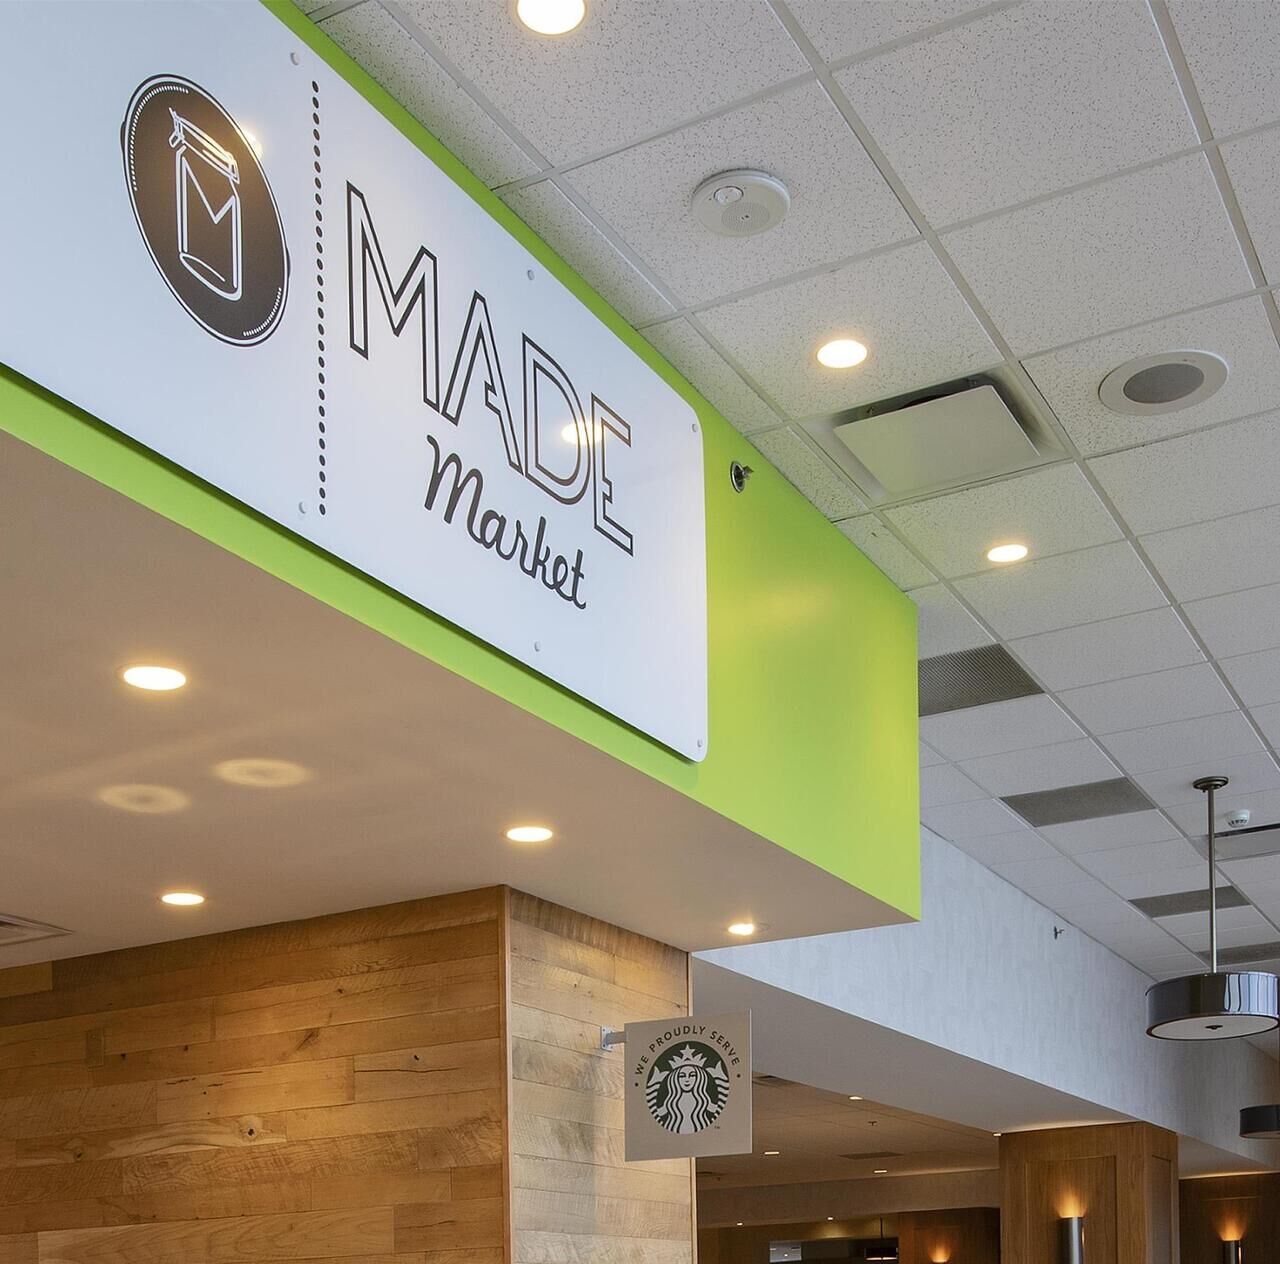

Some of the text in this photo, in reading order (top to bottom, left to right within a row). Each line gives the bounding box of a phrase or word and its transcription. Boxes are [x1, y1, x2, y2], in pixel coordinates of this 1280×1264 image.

[347, 181, 633, 556] MADE
[424, 435, 586, 609] Market
[635, 1026, 741, 1076] WE PROUDLY SERVE
